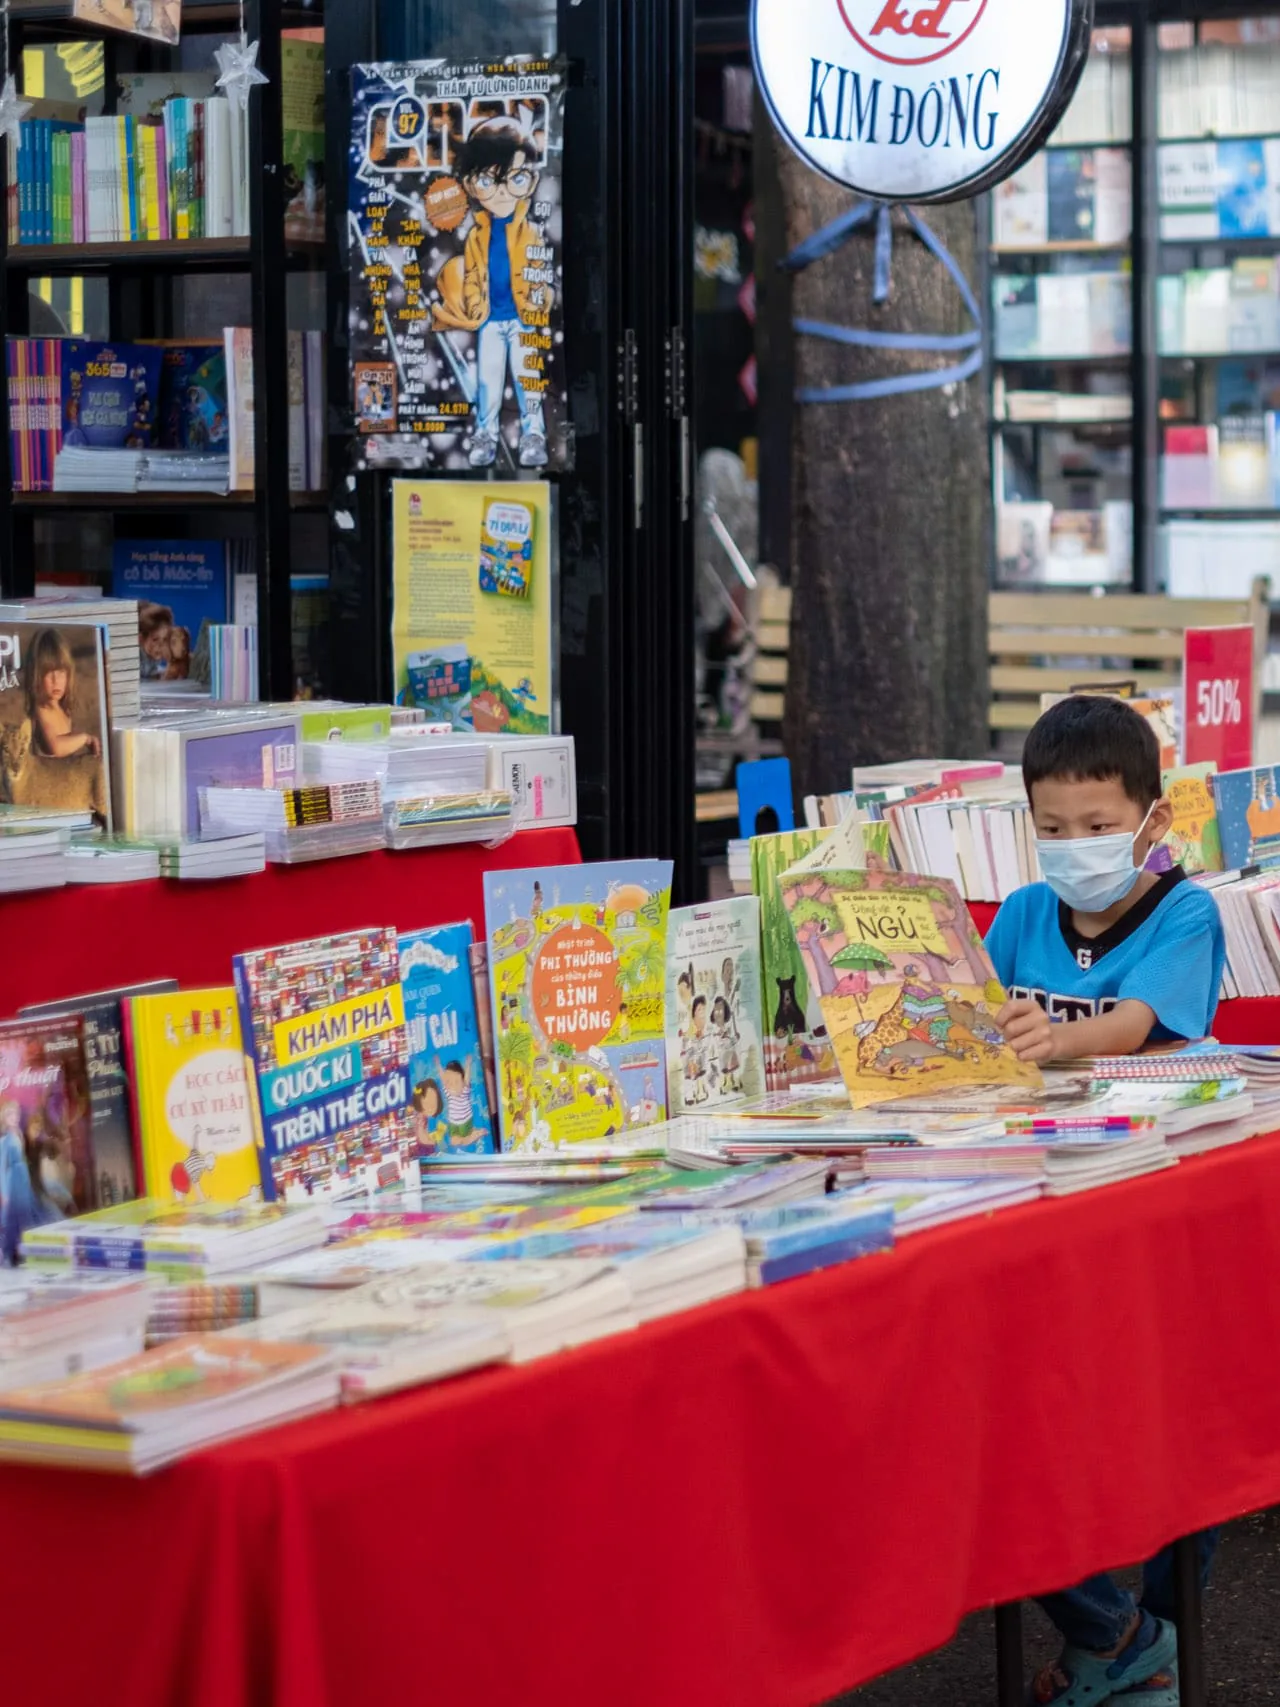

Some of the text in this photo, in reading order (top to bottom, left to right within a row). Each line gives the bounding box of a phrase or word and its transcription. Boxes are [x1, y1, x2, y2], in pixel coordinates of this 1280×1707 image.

[437, 75, 549, 97] THÁM TỬ LỪNG DANH
[805, 57, 1000, 151] KIM ĐỒNG
[399, 114, 418, 134] 97
[366, 207, 388, 218] LOẠT
[526, 246, 553, 260] QUAN
[124, 566, 140, 581] cô
[142, 565, 160, 581] bé
[1197, 678, 1242, 727] 50%
[855, 905, 919, 941] NGỦ
[540, 949, 612, 970] PHI THƯỜNG
[1076, 948, 1092, 969] G
[556, 983, 597, 1007] BÌNH
[288, 991, 393, 1056] KHÁM PHÁ
[544, 1007, 611, 1036] THƯỜNG
[185, 1072, 212, 1091] HỌC
[271, 1047, 353, 1107] QUỐC KÌ
[271, 1105, 325, 1150] TRÊN
[326, 1082, 367, 1130] THẾ
[366, 1070, 407, 1114] GIỚI
